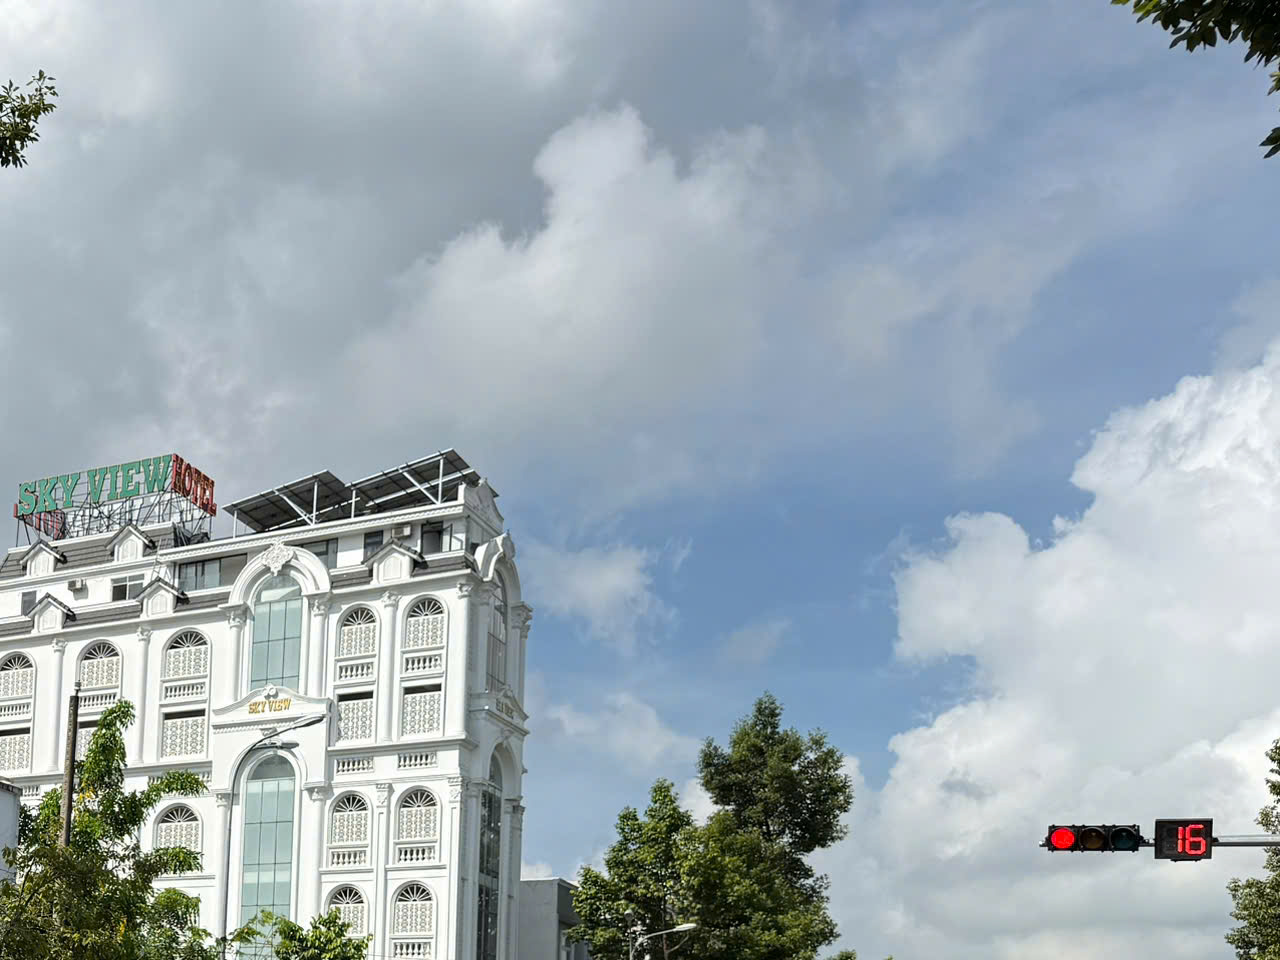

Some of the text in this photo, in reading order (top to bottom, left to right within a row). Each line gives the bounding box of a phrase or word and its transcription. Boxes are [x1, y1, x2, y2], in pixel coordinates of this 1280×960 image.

[17, 454, 173, 516] SKY VIEW
[171, 453, 218, 517] HOTEL
[248, 698, 292, 714] SKY VIEW
[1177, 824, 1206, 855] 16
